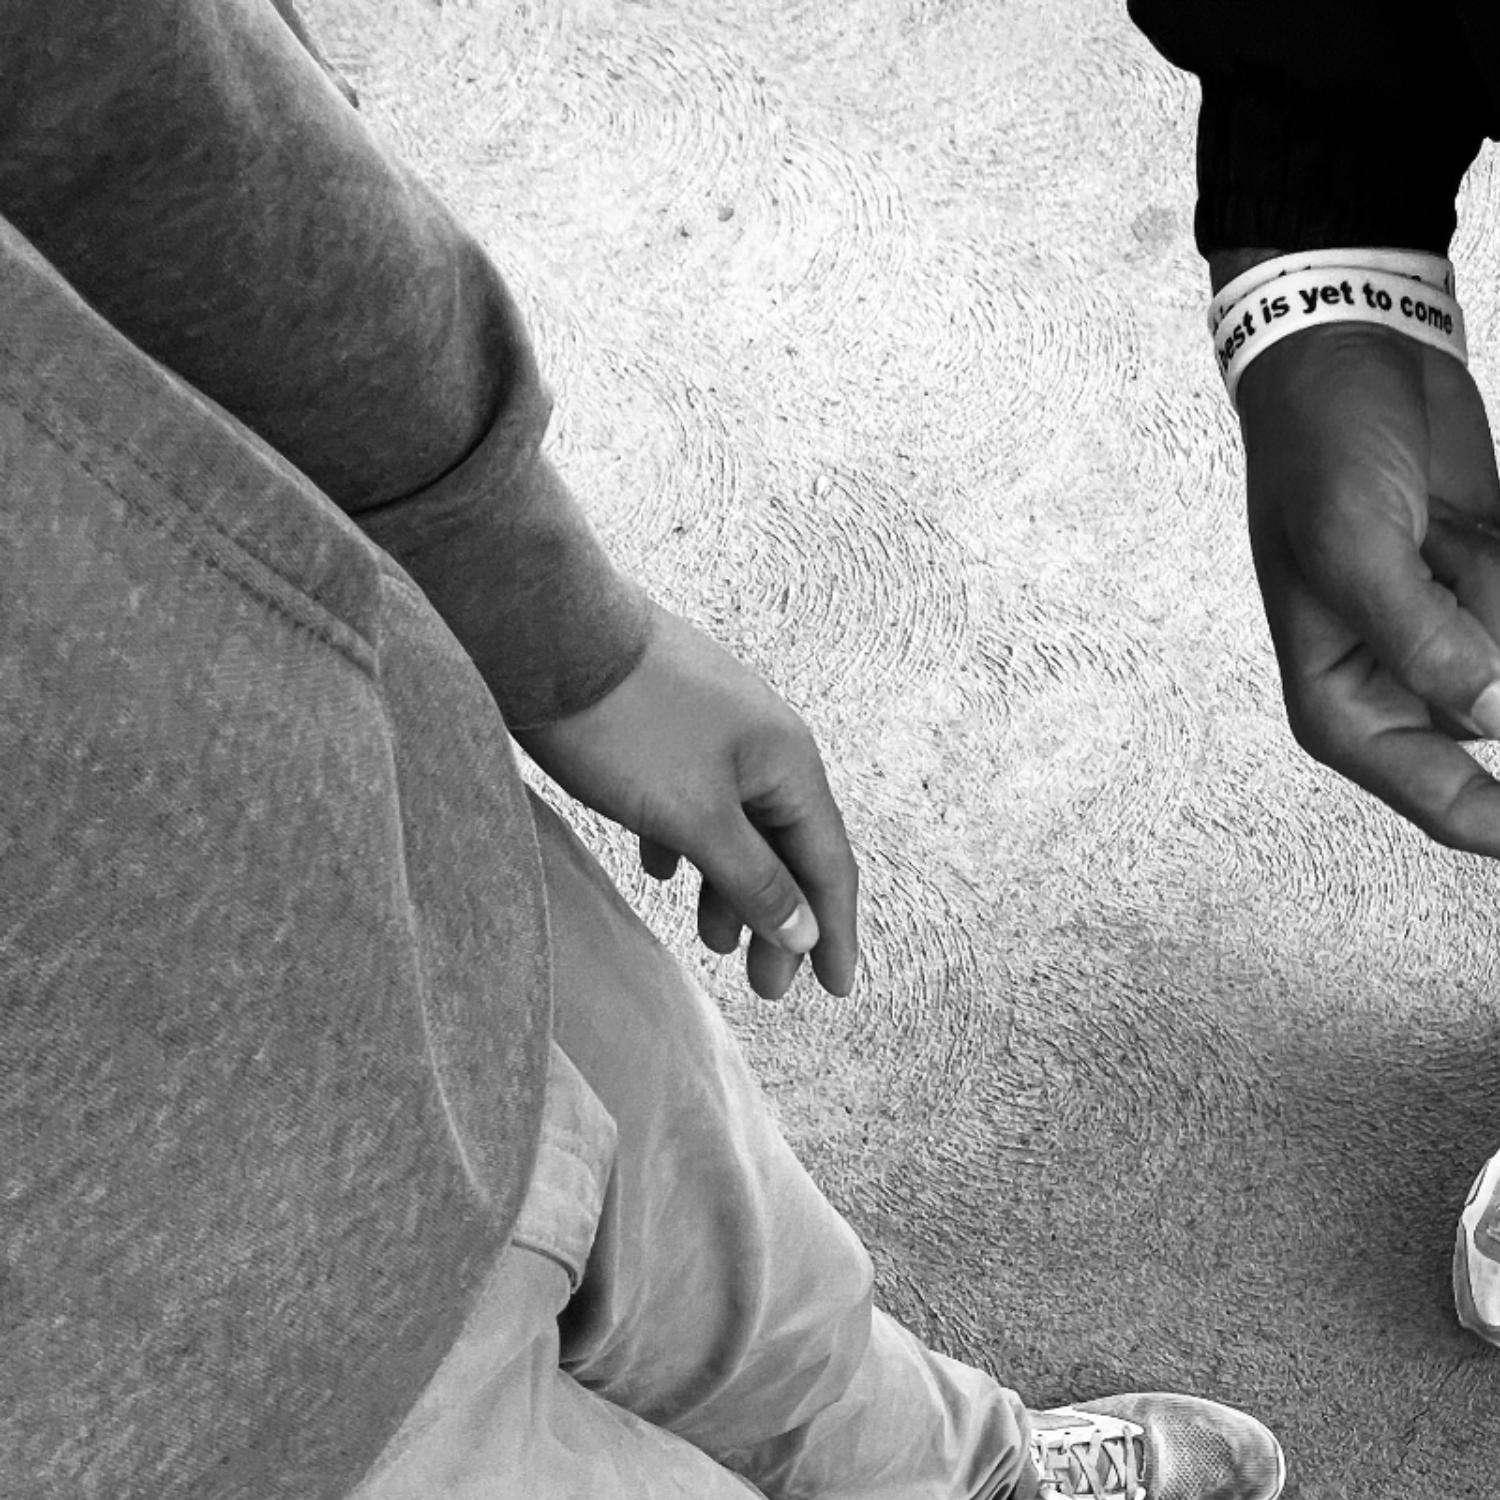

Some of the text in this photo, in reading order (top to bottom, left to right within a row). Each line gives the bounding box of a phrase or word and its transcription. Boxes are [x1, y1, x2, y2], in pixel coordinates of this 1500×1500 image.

[1259, 296, 1290, 324] is
[1298, 279, 1355, 315] yet
[1362, 280, 1393, 312] to
[1400, 295, 1454, 335] come
